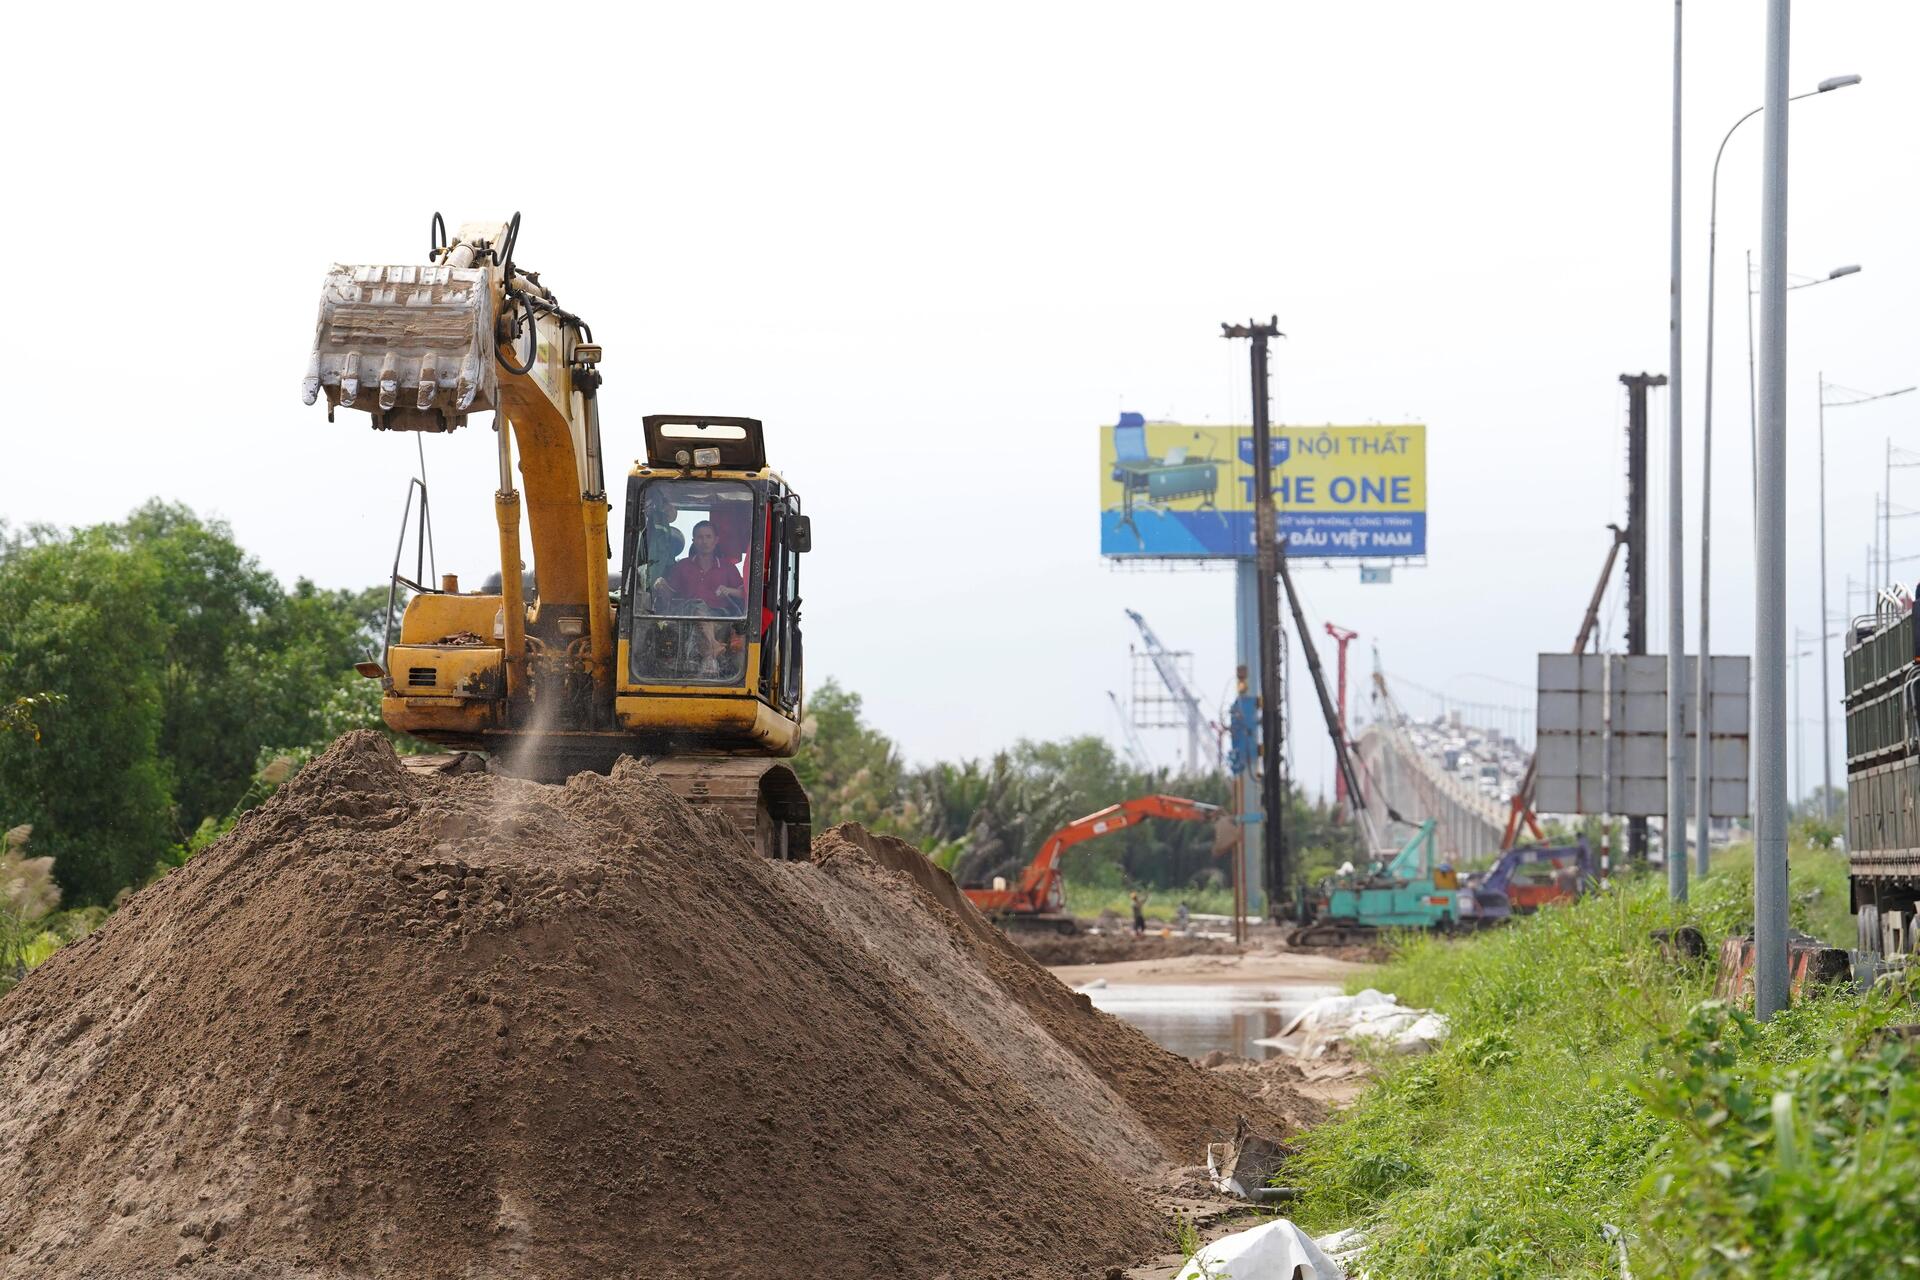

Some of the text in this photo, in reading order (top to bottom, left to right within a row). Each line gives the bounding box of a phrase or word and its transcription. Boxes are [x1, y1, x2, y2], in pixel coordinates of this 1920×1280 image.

[1297, 428, 1410, 459] NỘI THẤT
[1238, 475, 1412, 504] THE ONE
[1330, 530, 1370, 549] VIỆT
[1372, 532, 1413, 546] NAM
